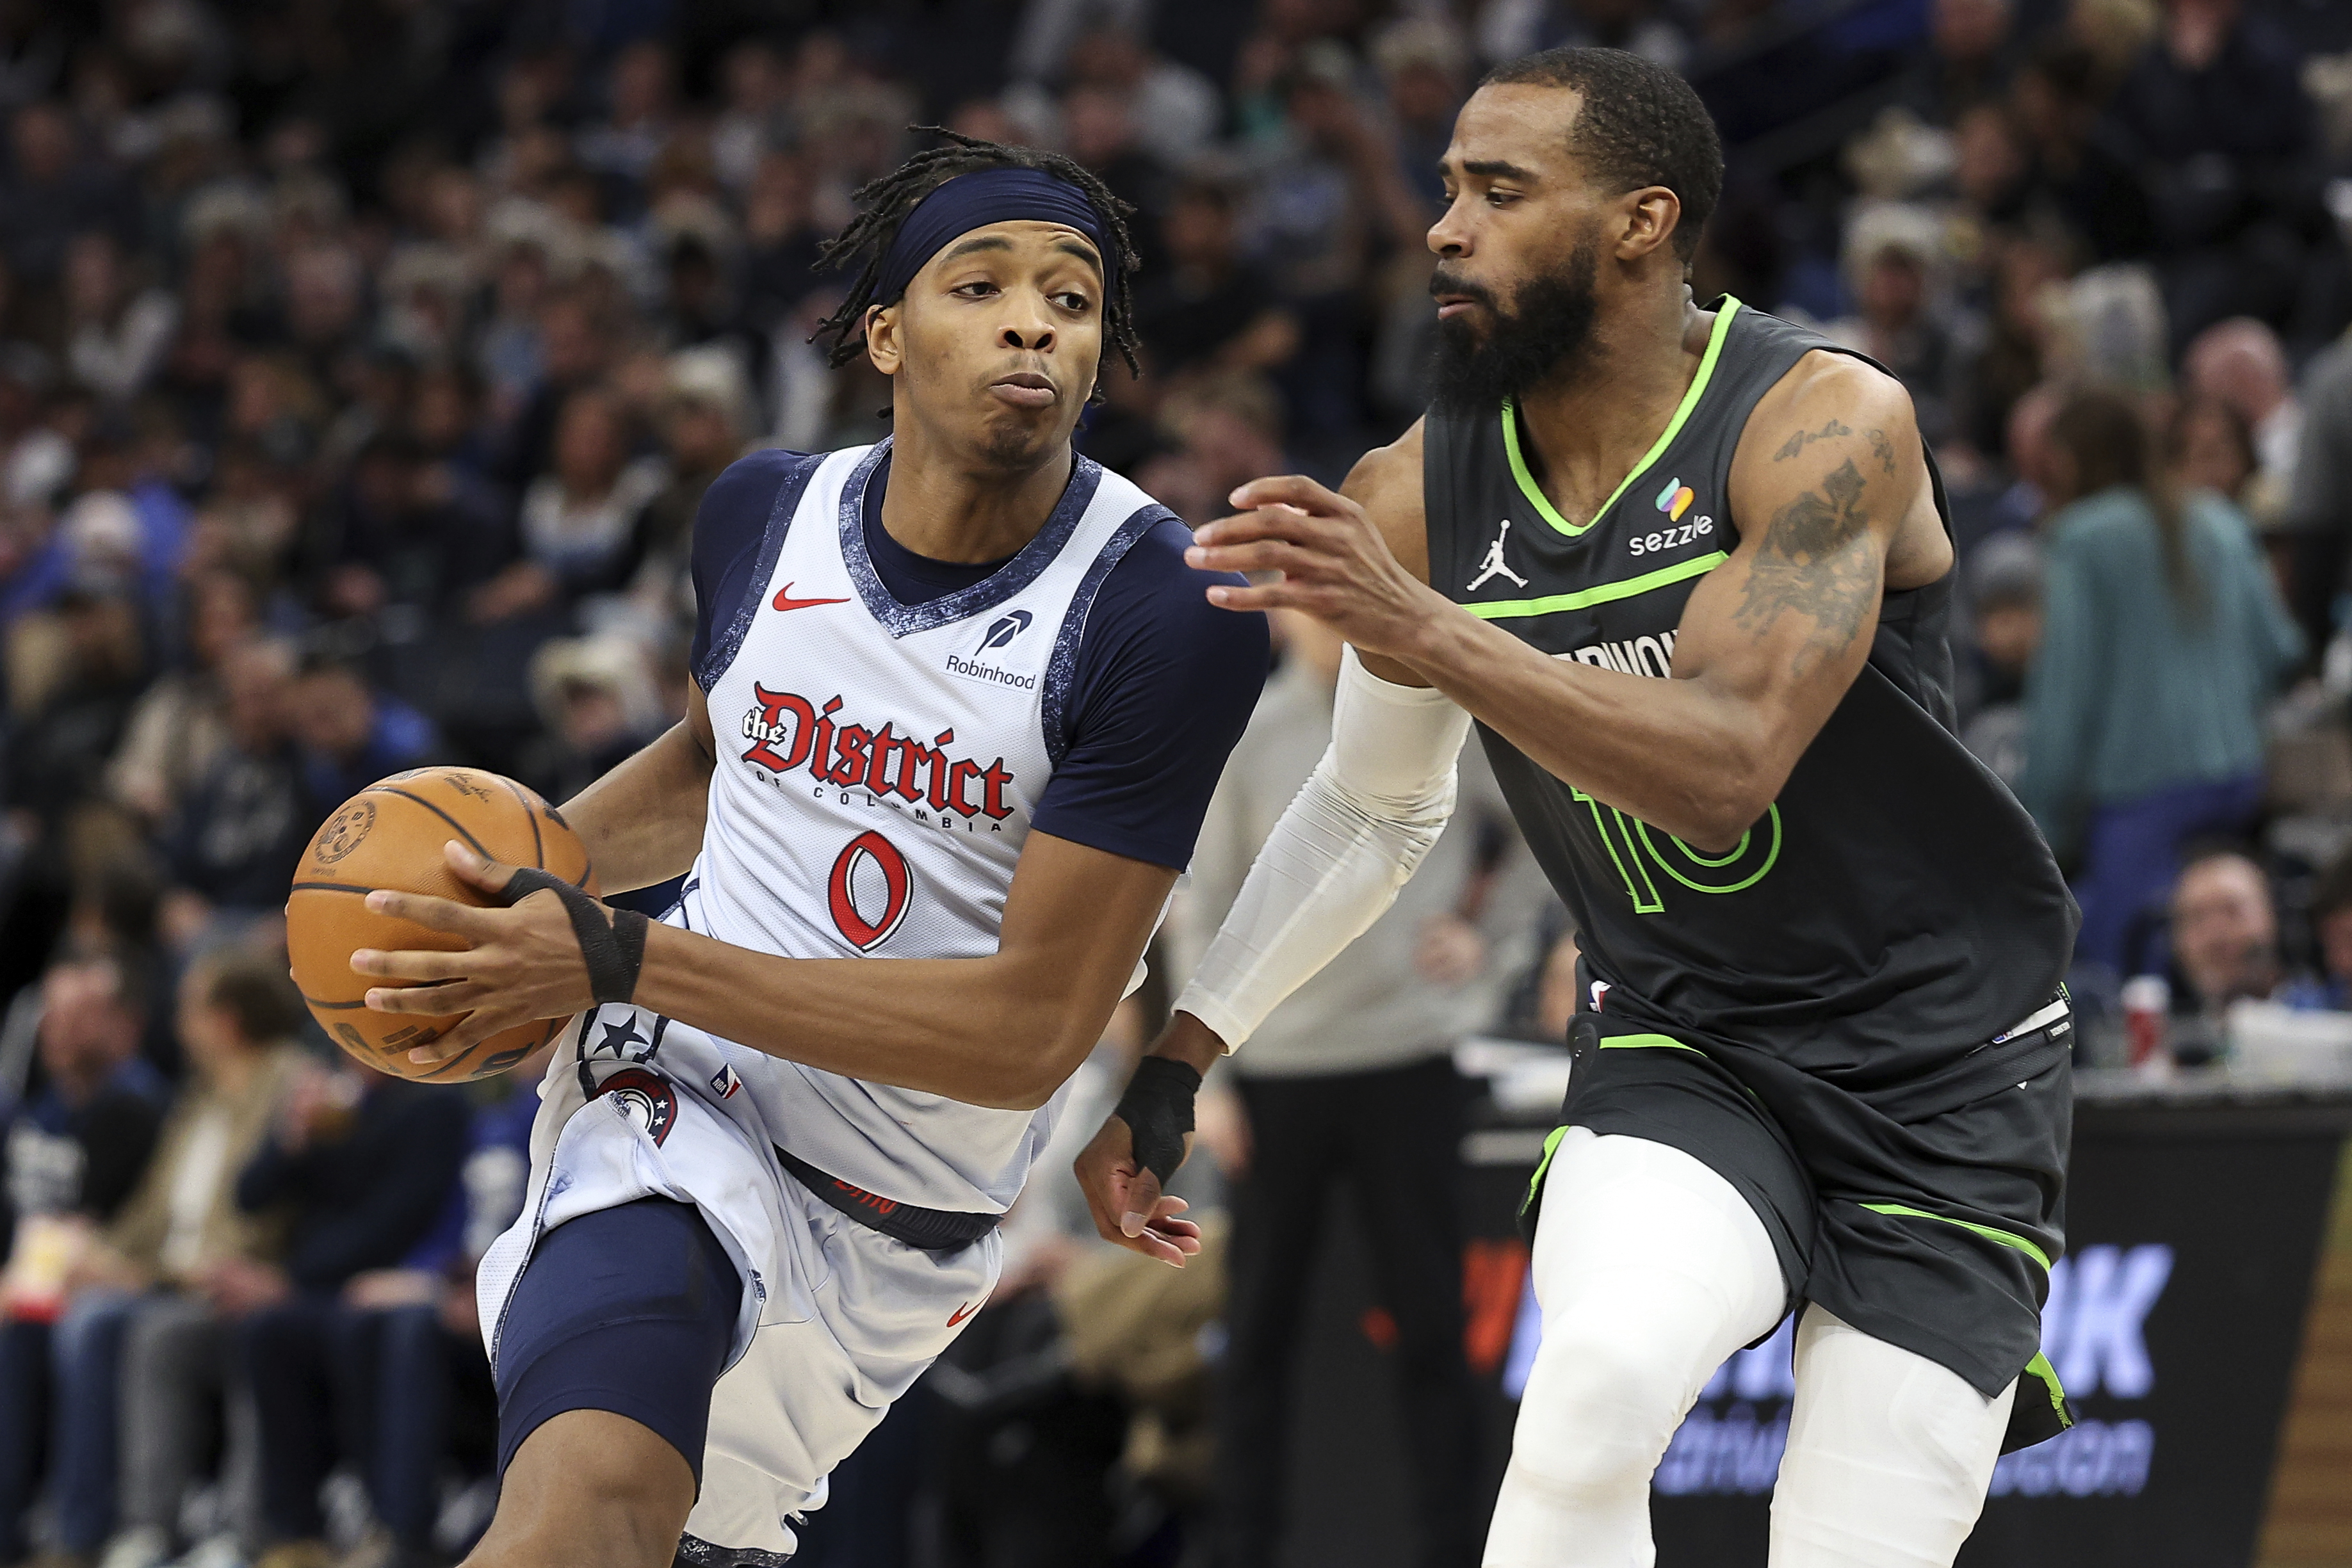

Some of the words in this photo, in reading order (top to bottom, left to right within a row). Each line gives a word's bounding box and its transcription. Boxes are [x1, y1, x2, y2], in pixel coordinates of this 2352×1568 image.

[1628, 514, 1713, 556] sezzle
[946, 654, 1036, 691] Robinhood
[742, 708, 786, 745] the
[741, 680, 1014, 821] District
[827, 829, 914, 953] 0
[711, 1077, 727, 1093] NBA
